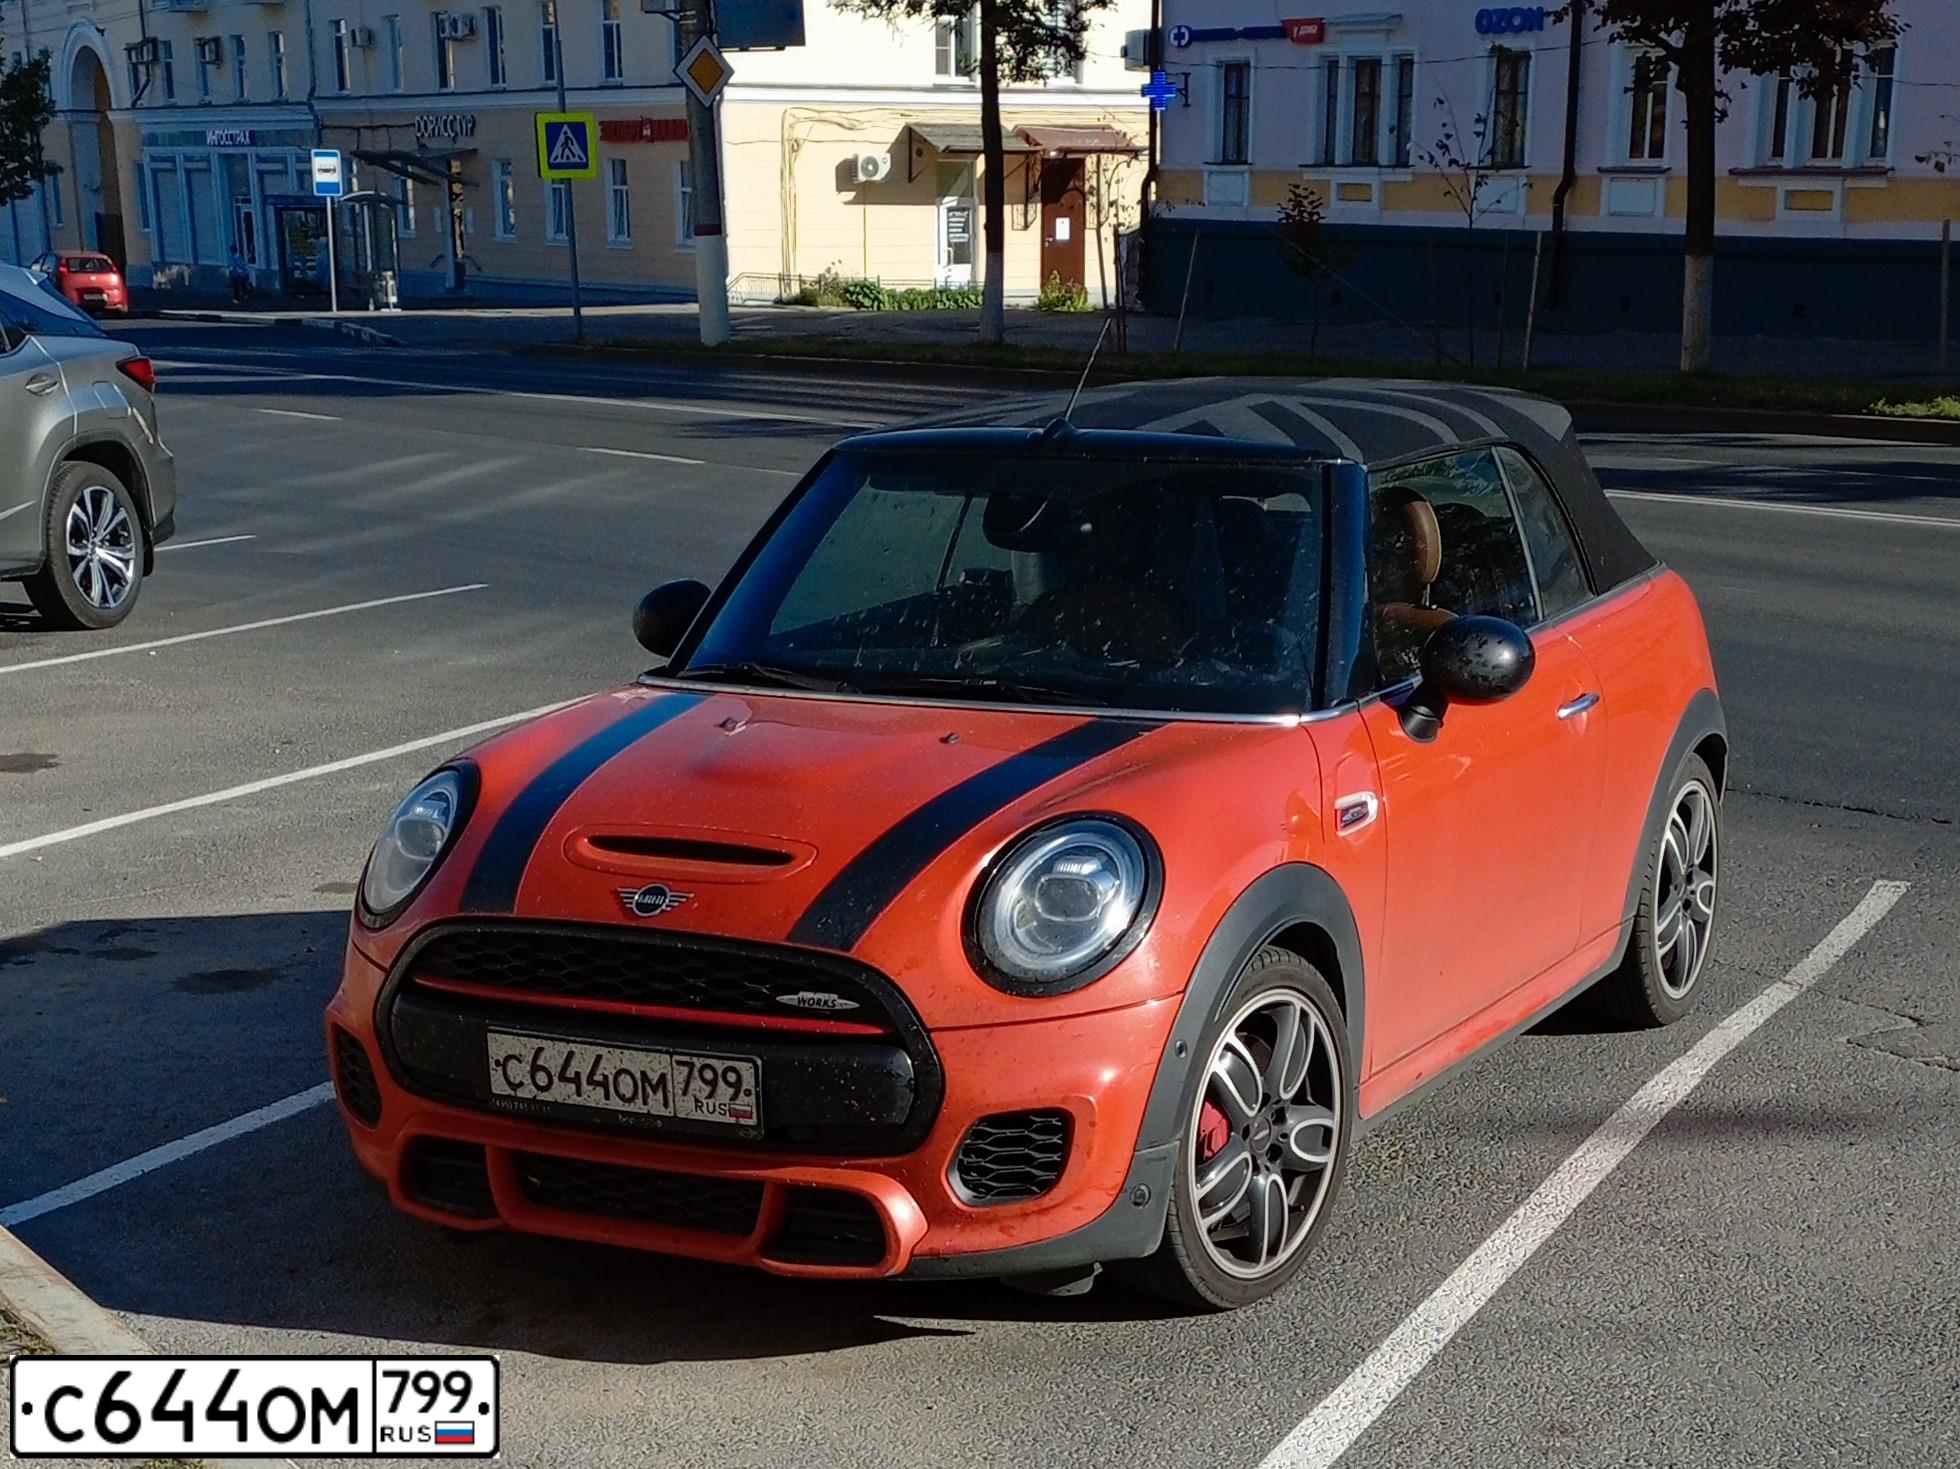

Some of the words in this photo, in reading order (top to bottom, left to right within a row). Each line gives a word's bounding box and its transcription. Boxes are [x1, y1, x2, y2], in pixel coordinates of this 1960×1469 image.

[1475, 7, 1544, 34] OZON
[797, 996, 837, 1008] WORKS
[675, 1060, 743, 1101] 799
[694, 1099, 728, 1117] RUS
